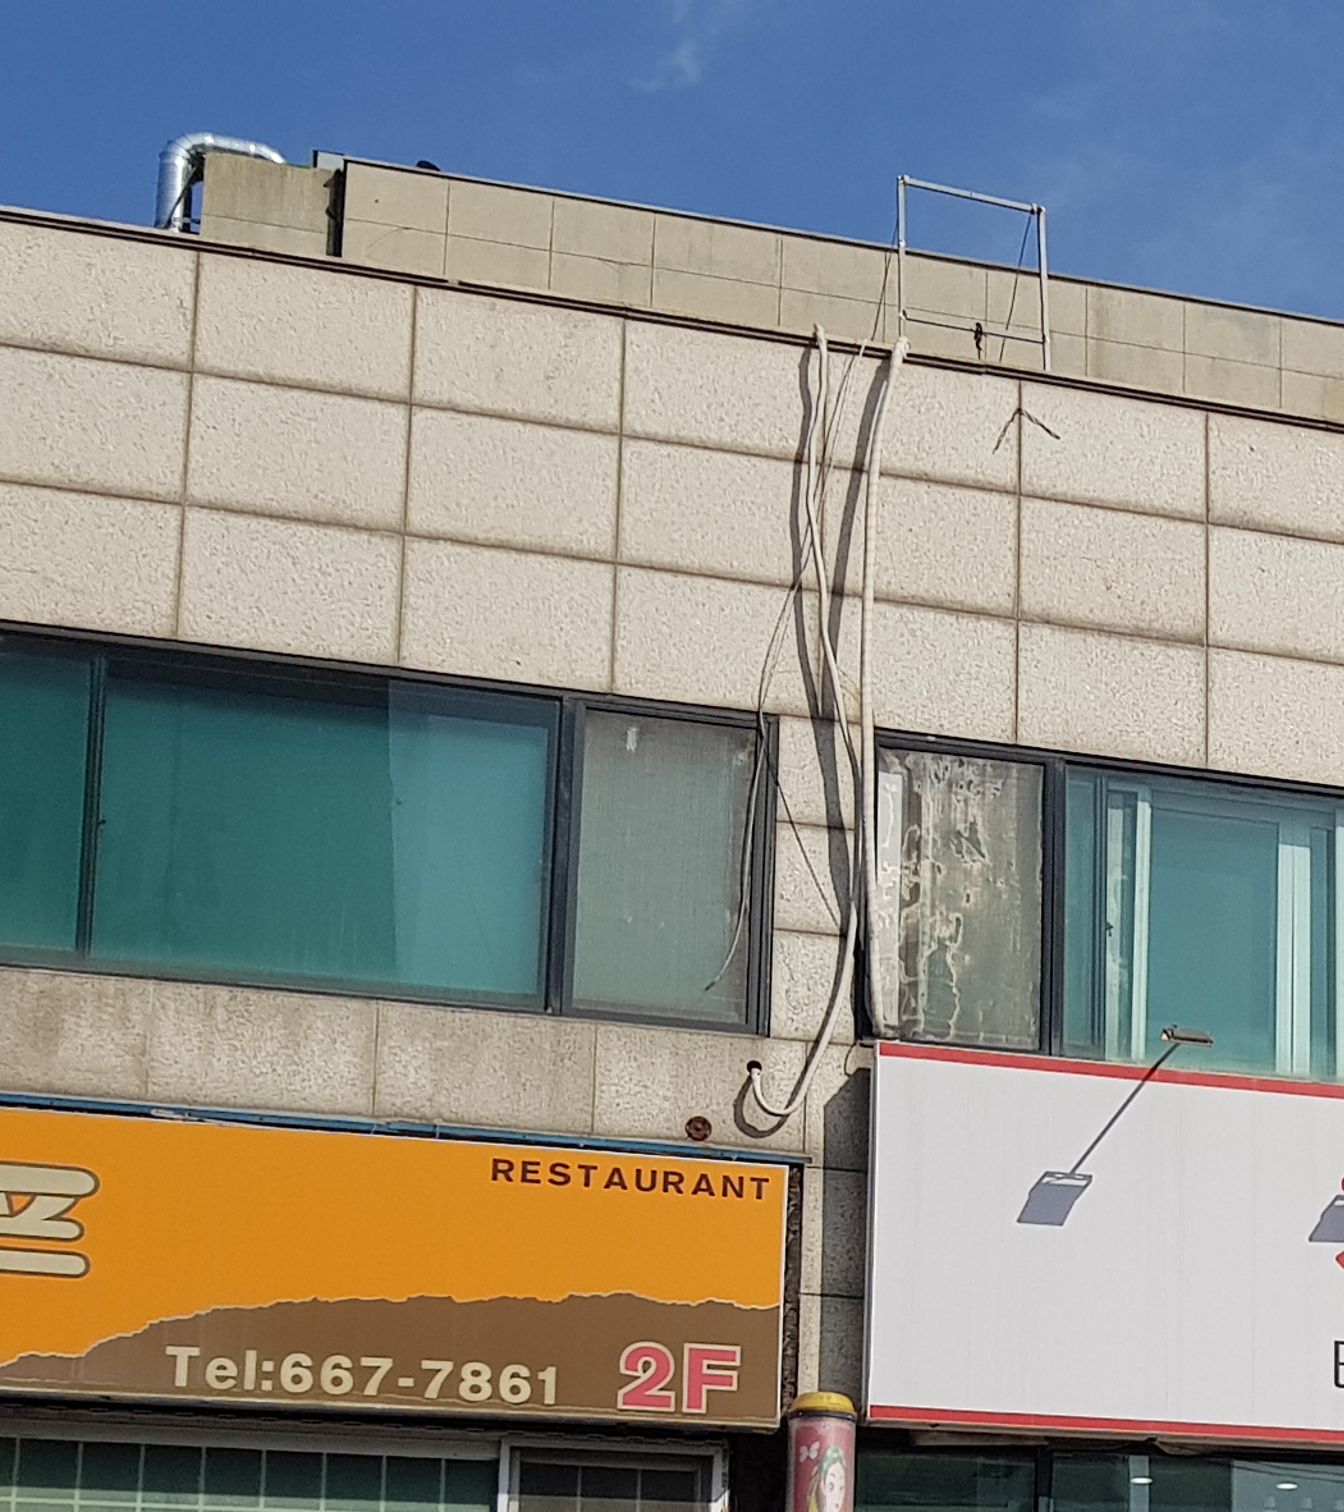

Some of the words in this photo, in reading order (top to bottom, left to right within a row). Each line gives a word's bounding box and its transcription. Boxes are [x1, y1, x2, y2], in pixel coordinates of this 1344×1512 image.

[491, 1157, 770, 1201] RESTAURANT
[165, 1345, 559, 1405] Tel:667-7861
[616, 1341, 742, 1414] 2F
